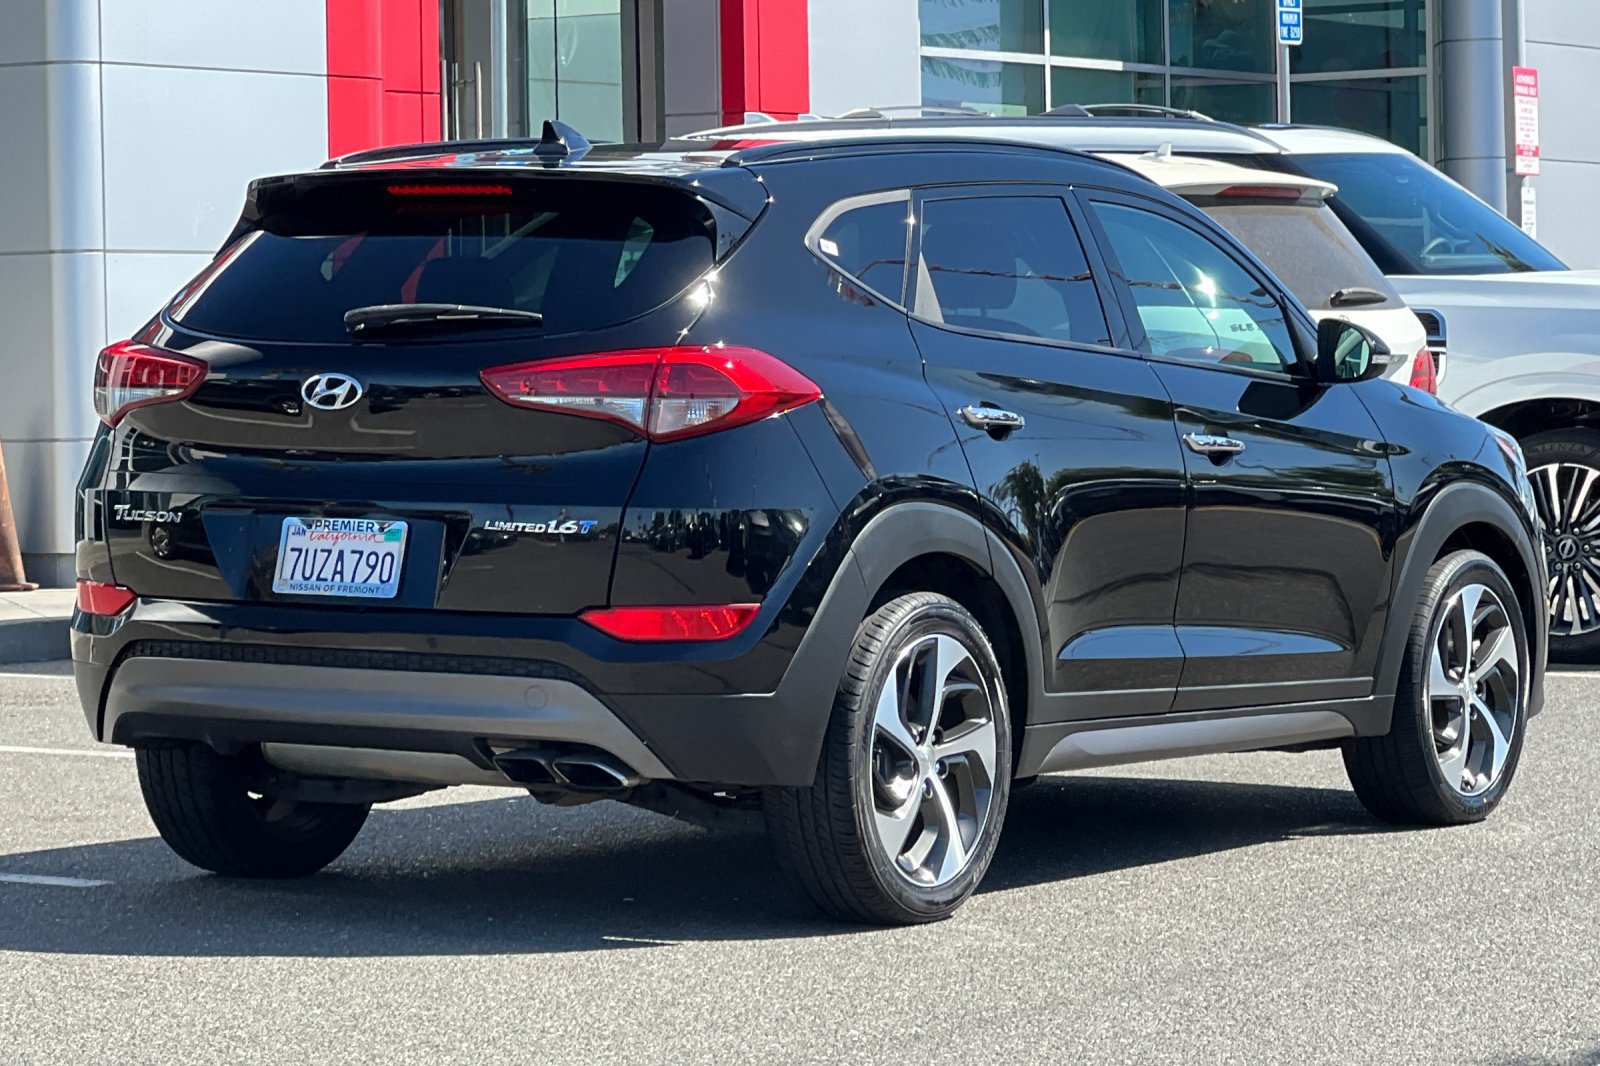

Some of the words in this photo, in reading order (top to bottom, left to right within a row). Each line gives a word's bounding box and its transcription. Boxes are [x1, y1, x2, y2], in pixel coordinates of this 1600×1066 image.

[291, 526, 307, 536] JAN
[314, 519, 375, 532] PREMIER
[484, 520, 546, 533] LIMITED
[309, 530, 384, 546] California
[290, 547, 395, 584] 7UZA790
[289, 583, 321, 592] NISSAN
[337, 585, 380, 594] FREMONT
